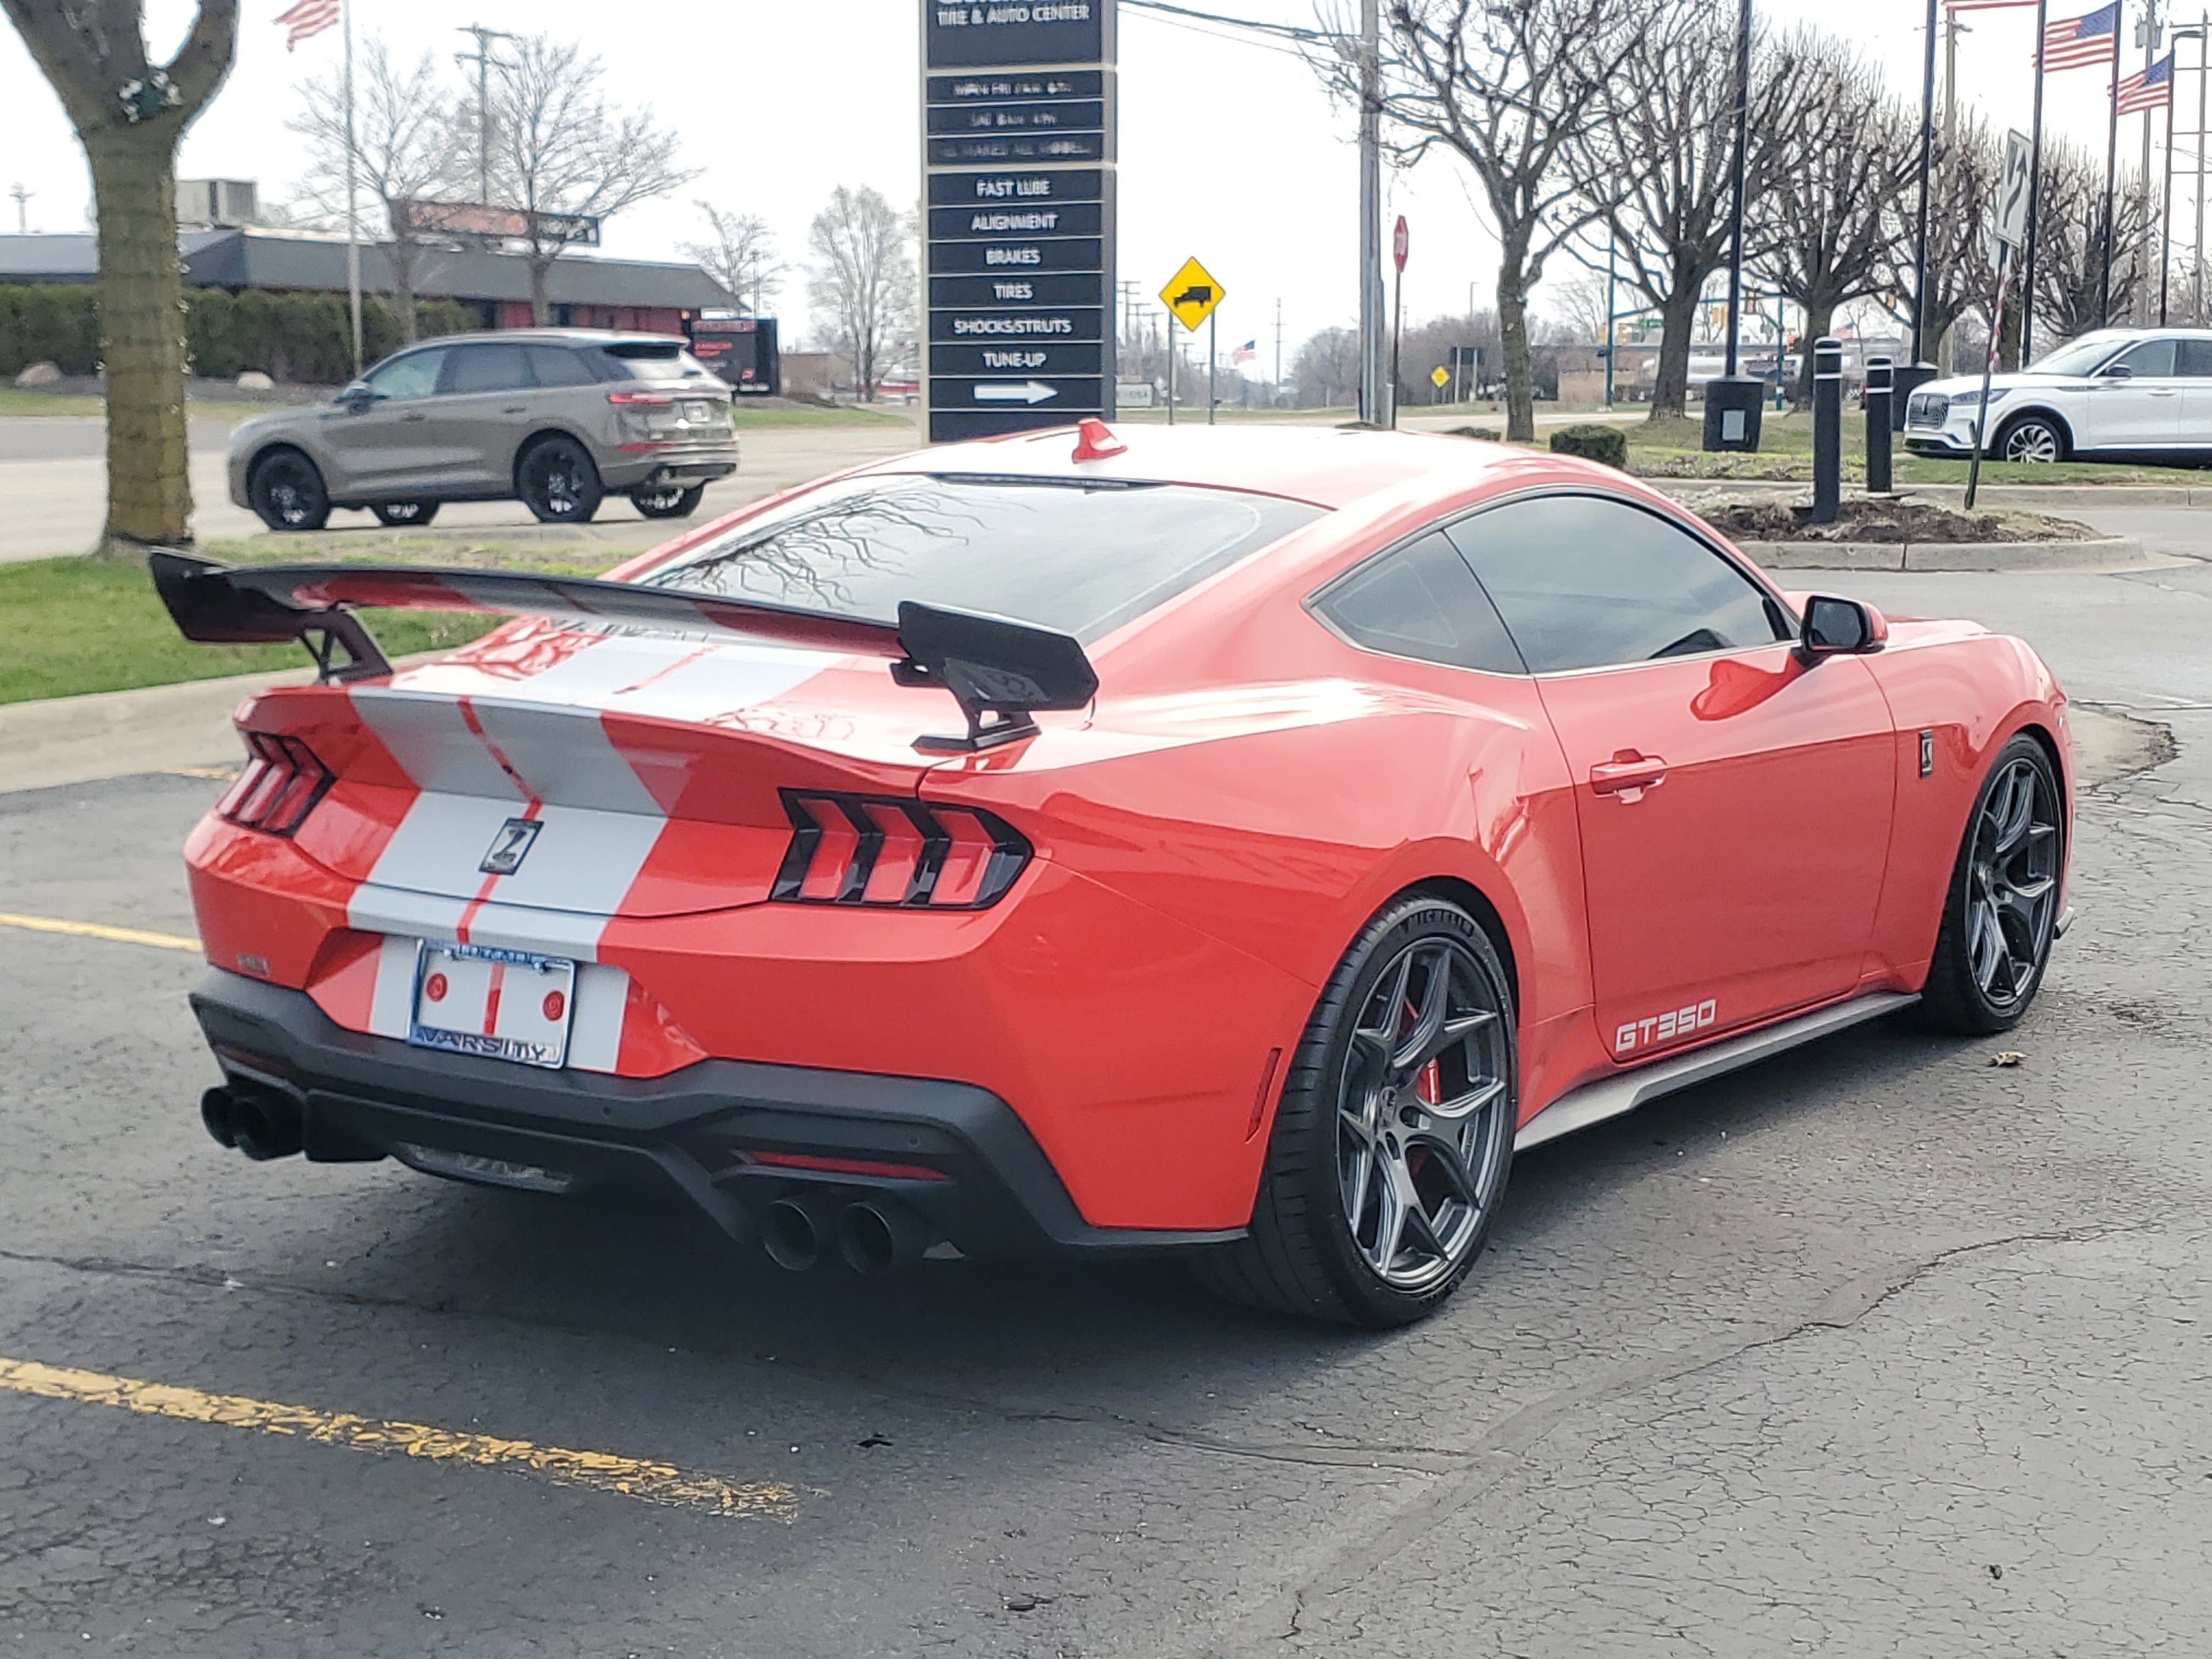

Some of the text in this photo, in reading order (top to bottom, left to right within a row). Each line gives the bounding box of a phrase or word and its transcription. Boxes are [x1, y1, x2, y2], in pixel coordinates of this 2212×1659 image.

[986, 7, 1030, 24] AUTO
[1031, 5, 1090, 22] CENTER
[977, 180, 1015, 197] FAST
[970, 213, 1059, 231] ALIGNMENT
[986, 248, 1041, 265] BRAKES
[993, 283, 1034, 300] TIRES
[983, 352, 1047, 368] TUNE-UP
[1616, 998, 1717, 1052] GT350
[423, 1026, 547, 1061] VARSITY
